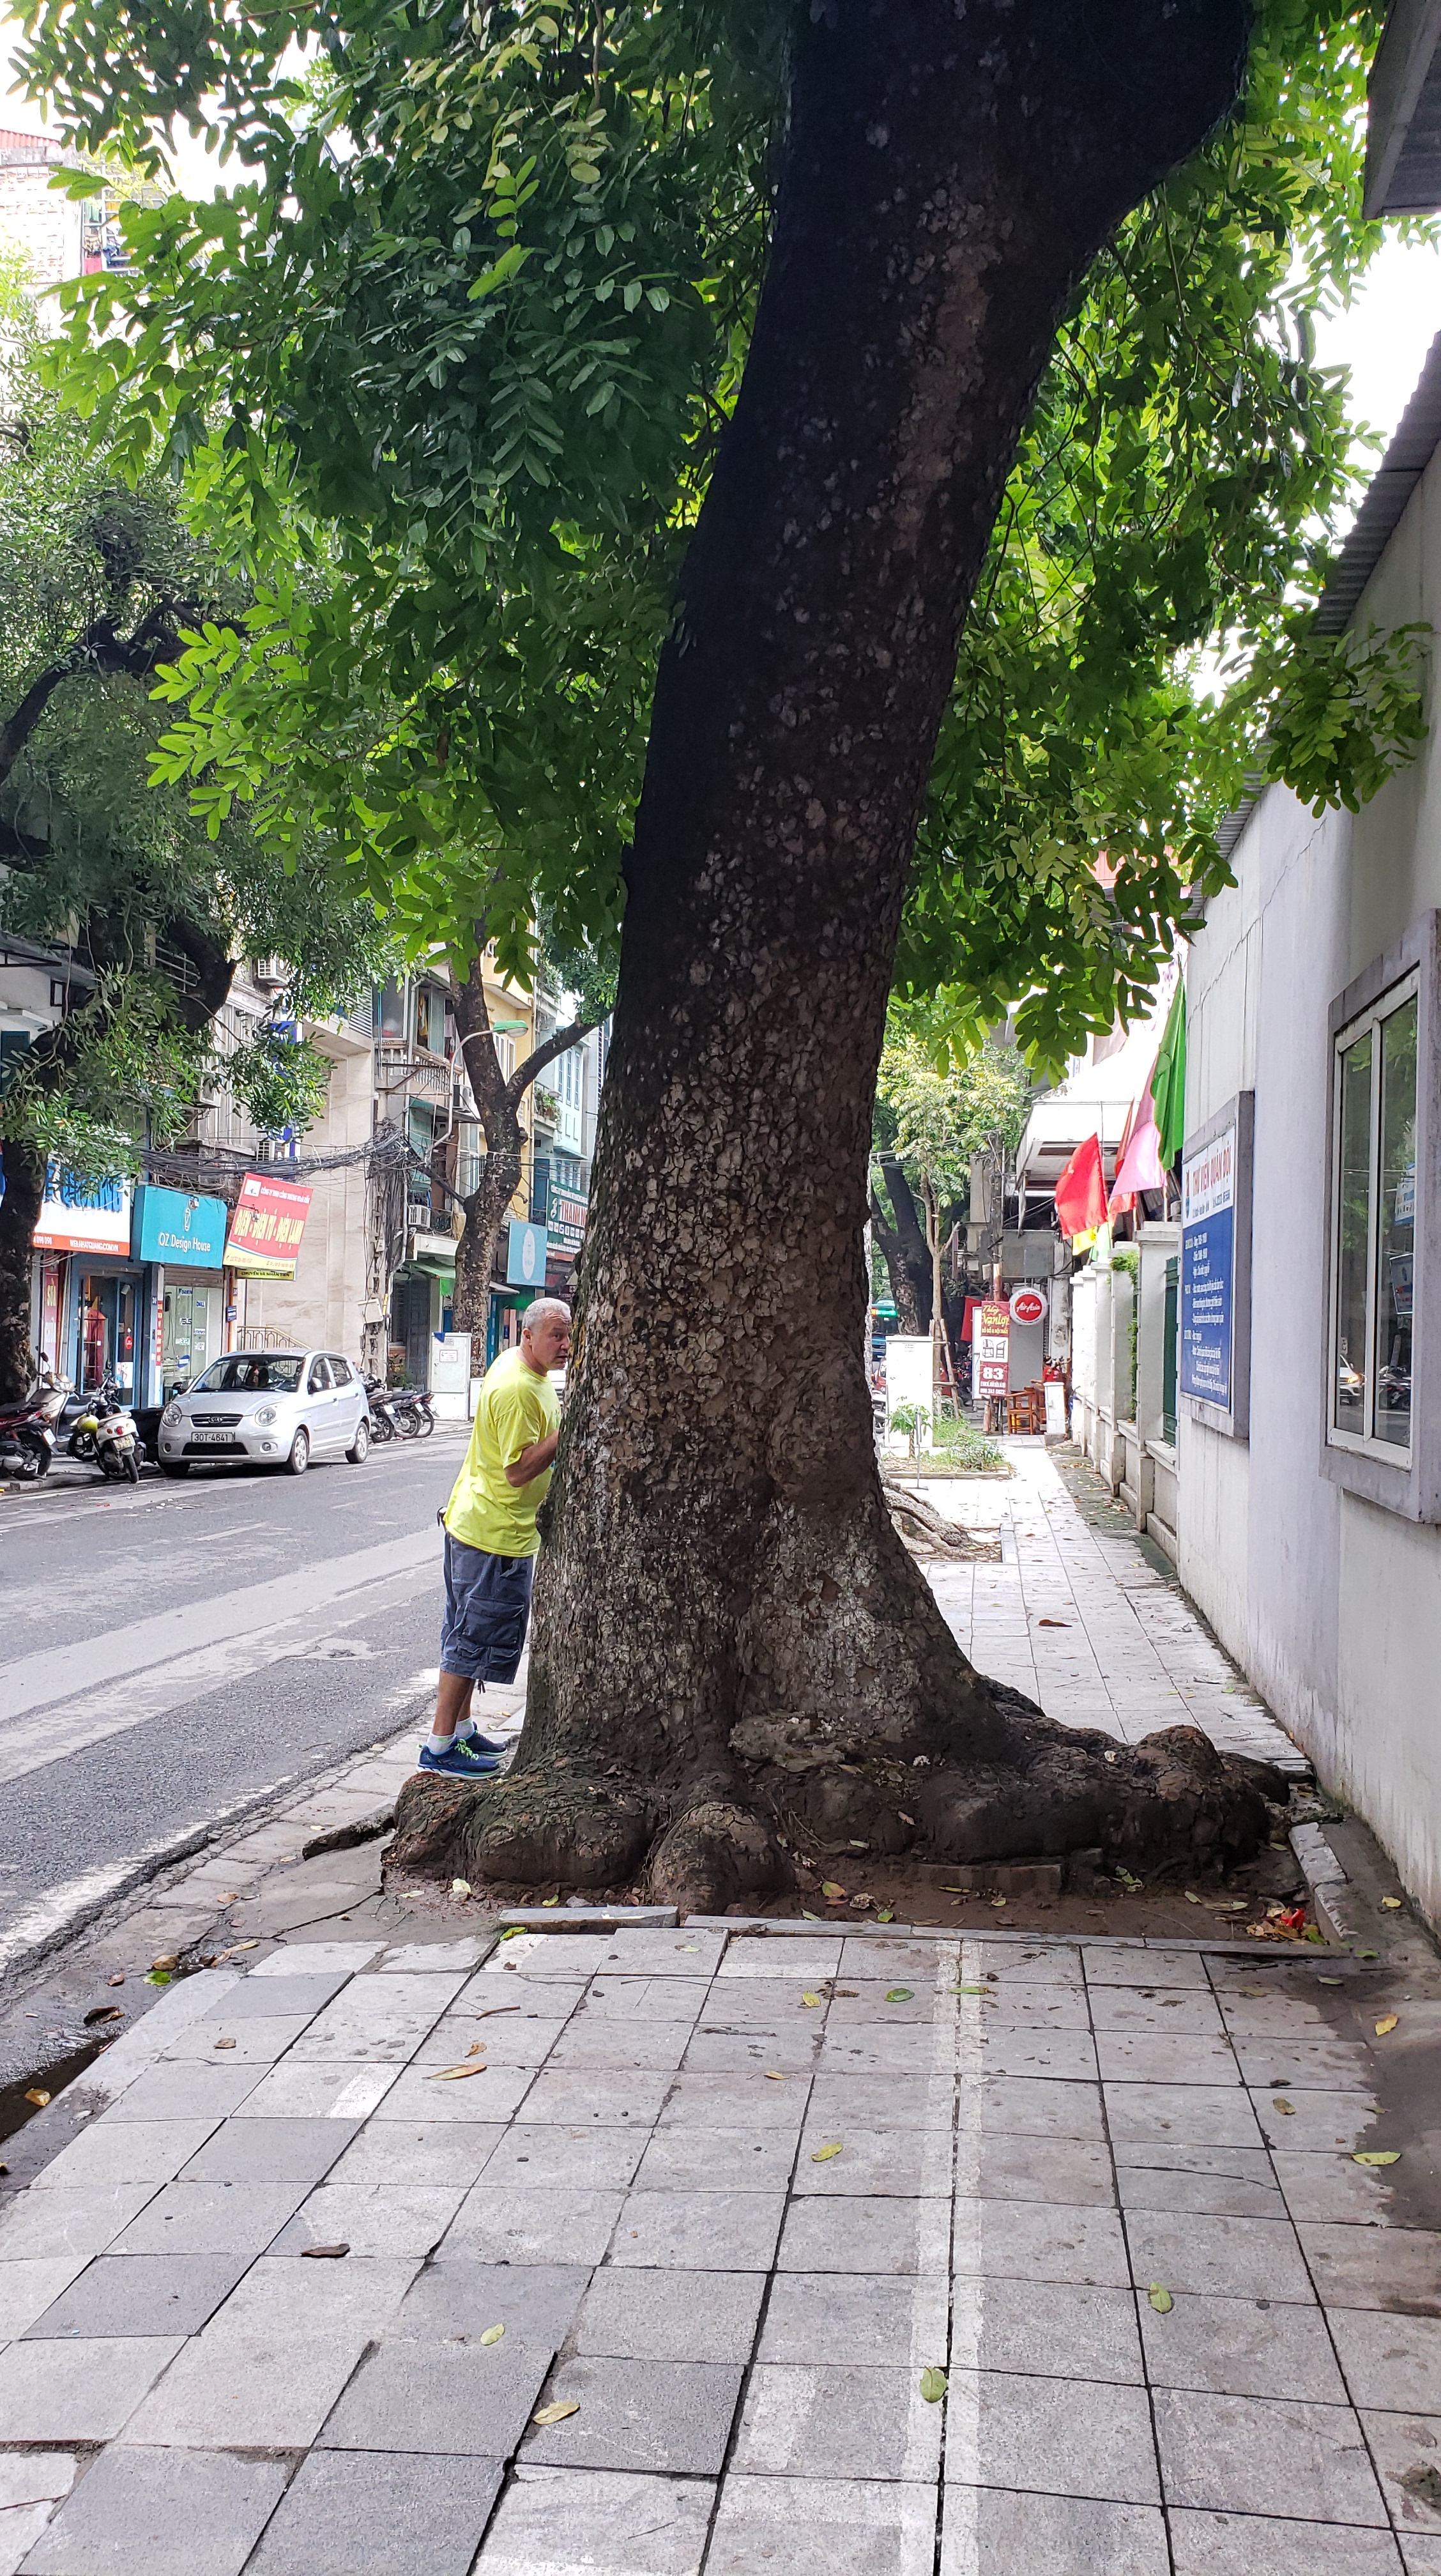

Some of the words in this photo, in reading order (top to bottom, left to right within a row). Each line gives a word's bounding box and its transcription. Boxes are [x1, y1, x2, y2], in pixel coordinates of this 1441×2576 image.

[1201, 1158, 1209, 1196] VIỆN
[1210, 1148, 1223, 1188] QUÂN
[159, 1232, 170, 1247] OZ
[171, 1234, 192, 1253] Design
[193, 1237, 211, 1252] House
[982, 1367, 1004, 1380] 83
[194, 1433, 229, 1441] 30T-4641
